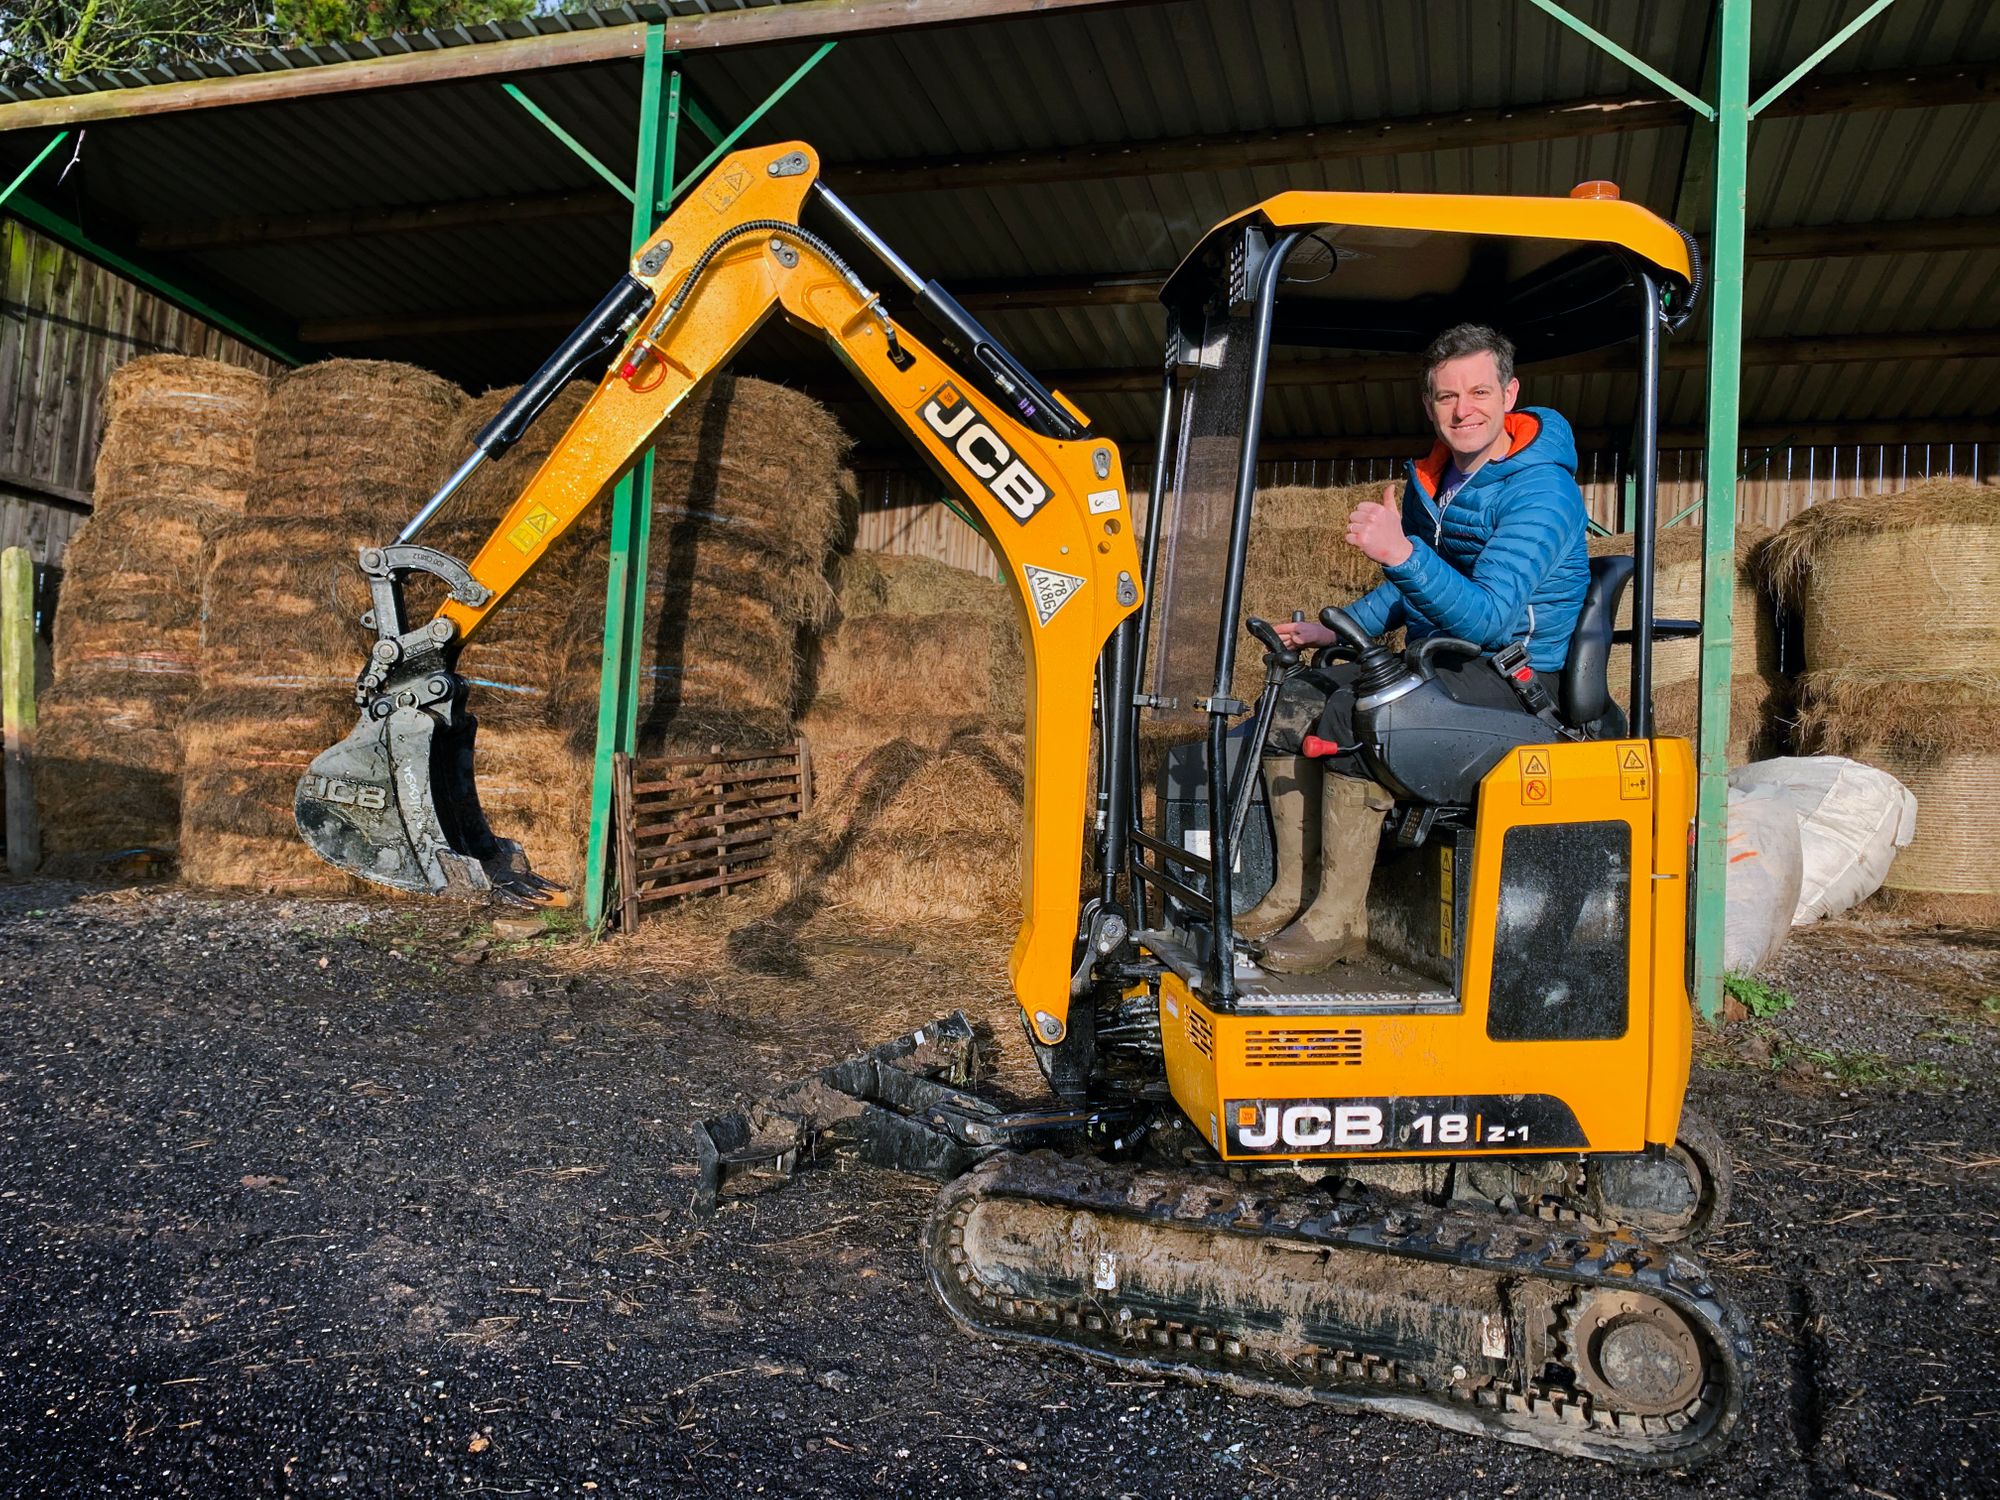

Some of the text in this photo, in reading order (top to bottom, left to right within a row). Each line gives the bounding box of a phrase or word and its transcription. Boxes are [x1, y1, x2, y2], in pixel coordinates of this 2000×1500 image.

[924, 400, 1046, 519] JCB
[1035, 576, 1057, 610] AX8G
[1053, 579, 1068, 597] 78
[302, 775, 386, 810] JCB
[1238, 1106, 1383, 1148] JCB
[1412, 1114, 1468, 1144] 18
